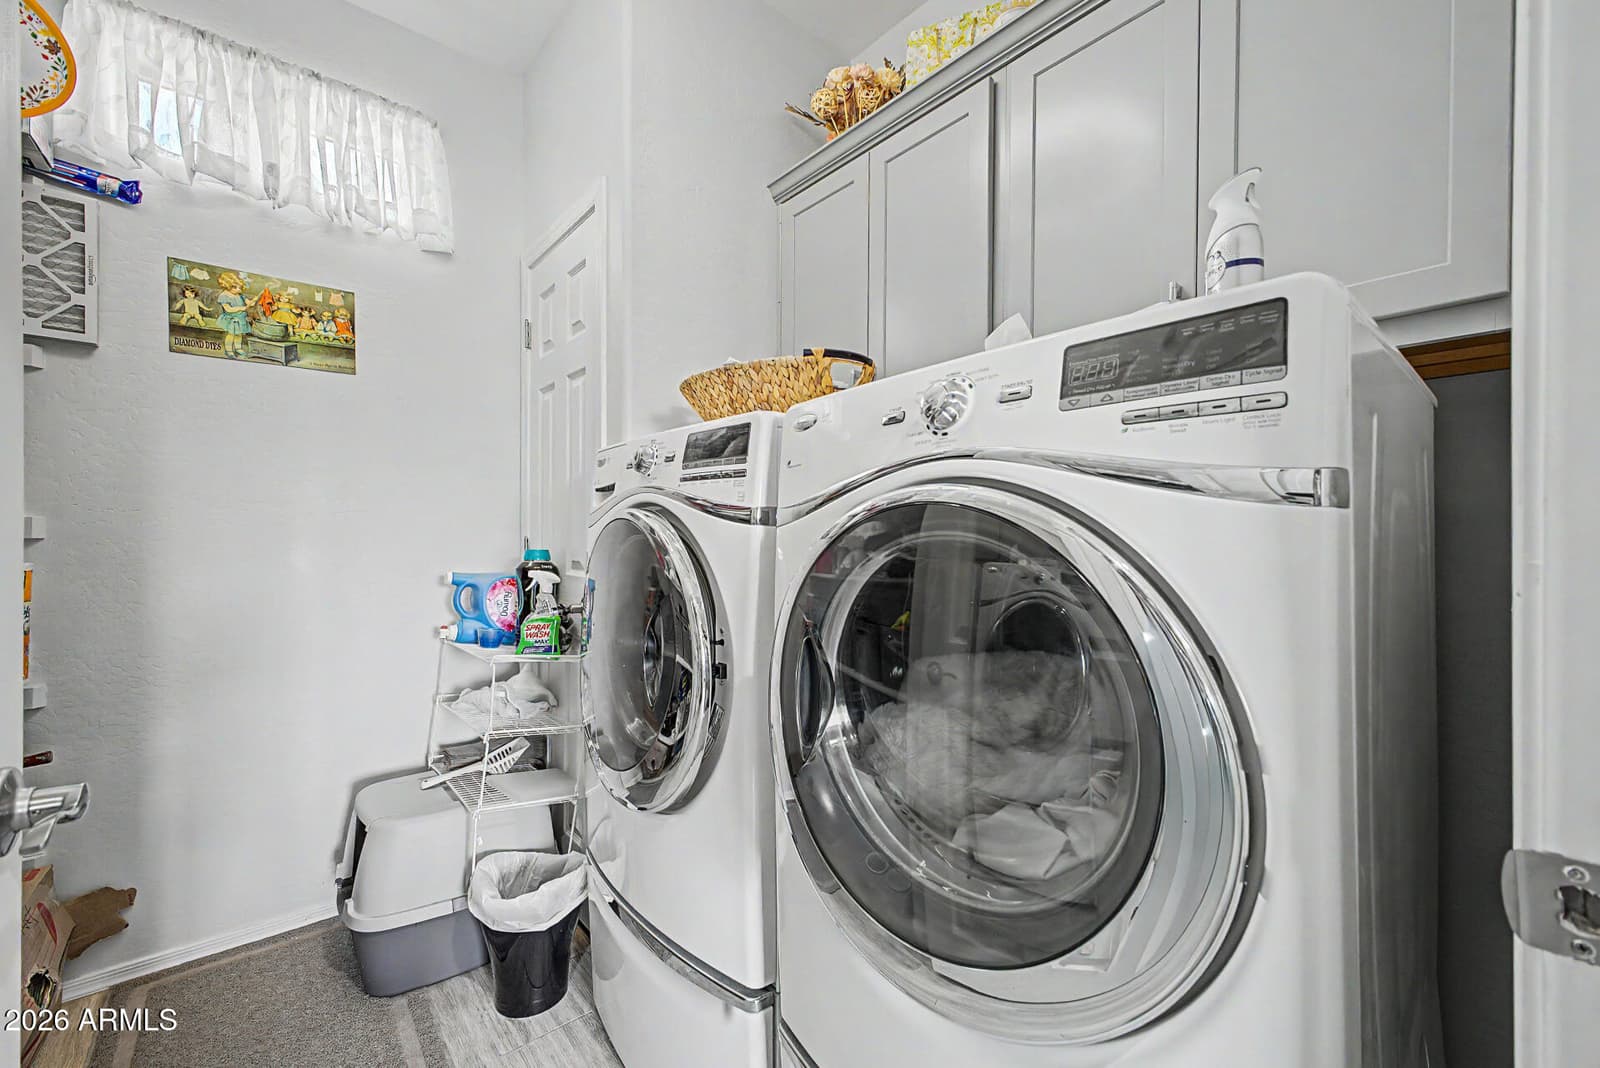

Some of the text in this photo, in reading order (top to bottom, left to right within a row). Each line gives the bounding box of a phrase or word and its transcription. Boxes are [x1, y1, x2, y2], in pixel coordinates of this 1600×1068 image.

[174, 337, 222, 351] DIAMOND DYES
[500, 591, 513, 617] Downy
[525, 623, 551, 631] SPRAY
[525, 631, 551, 639] WASH
